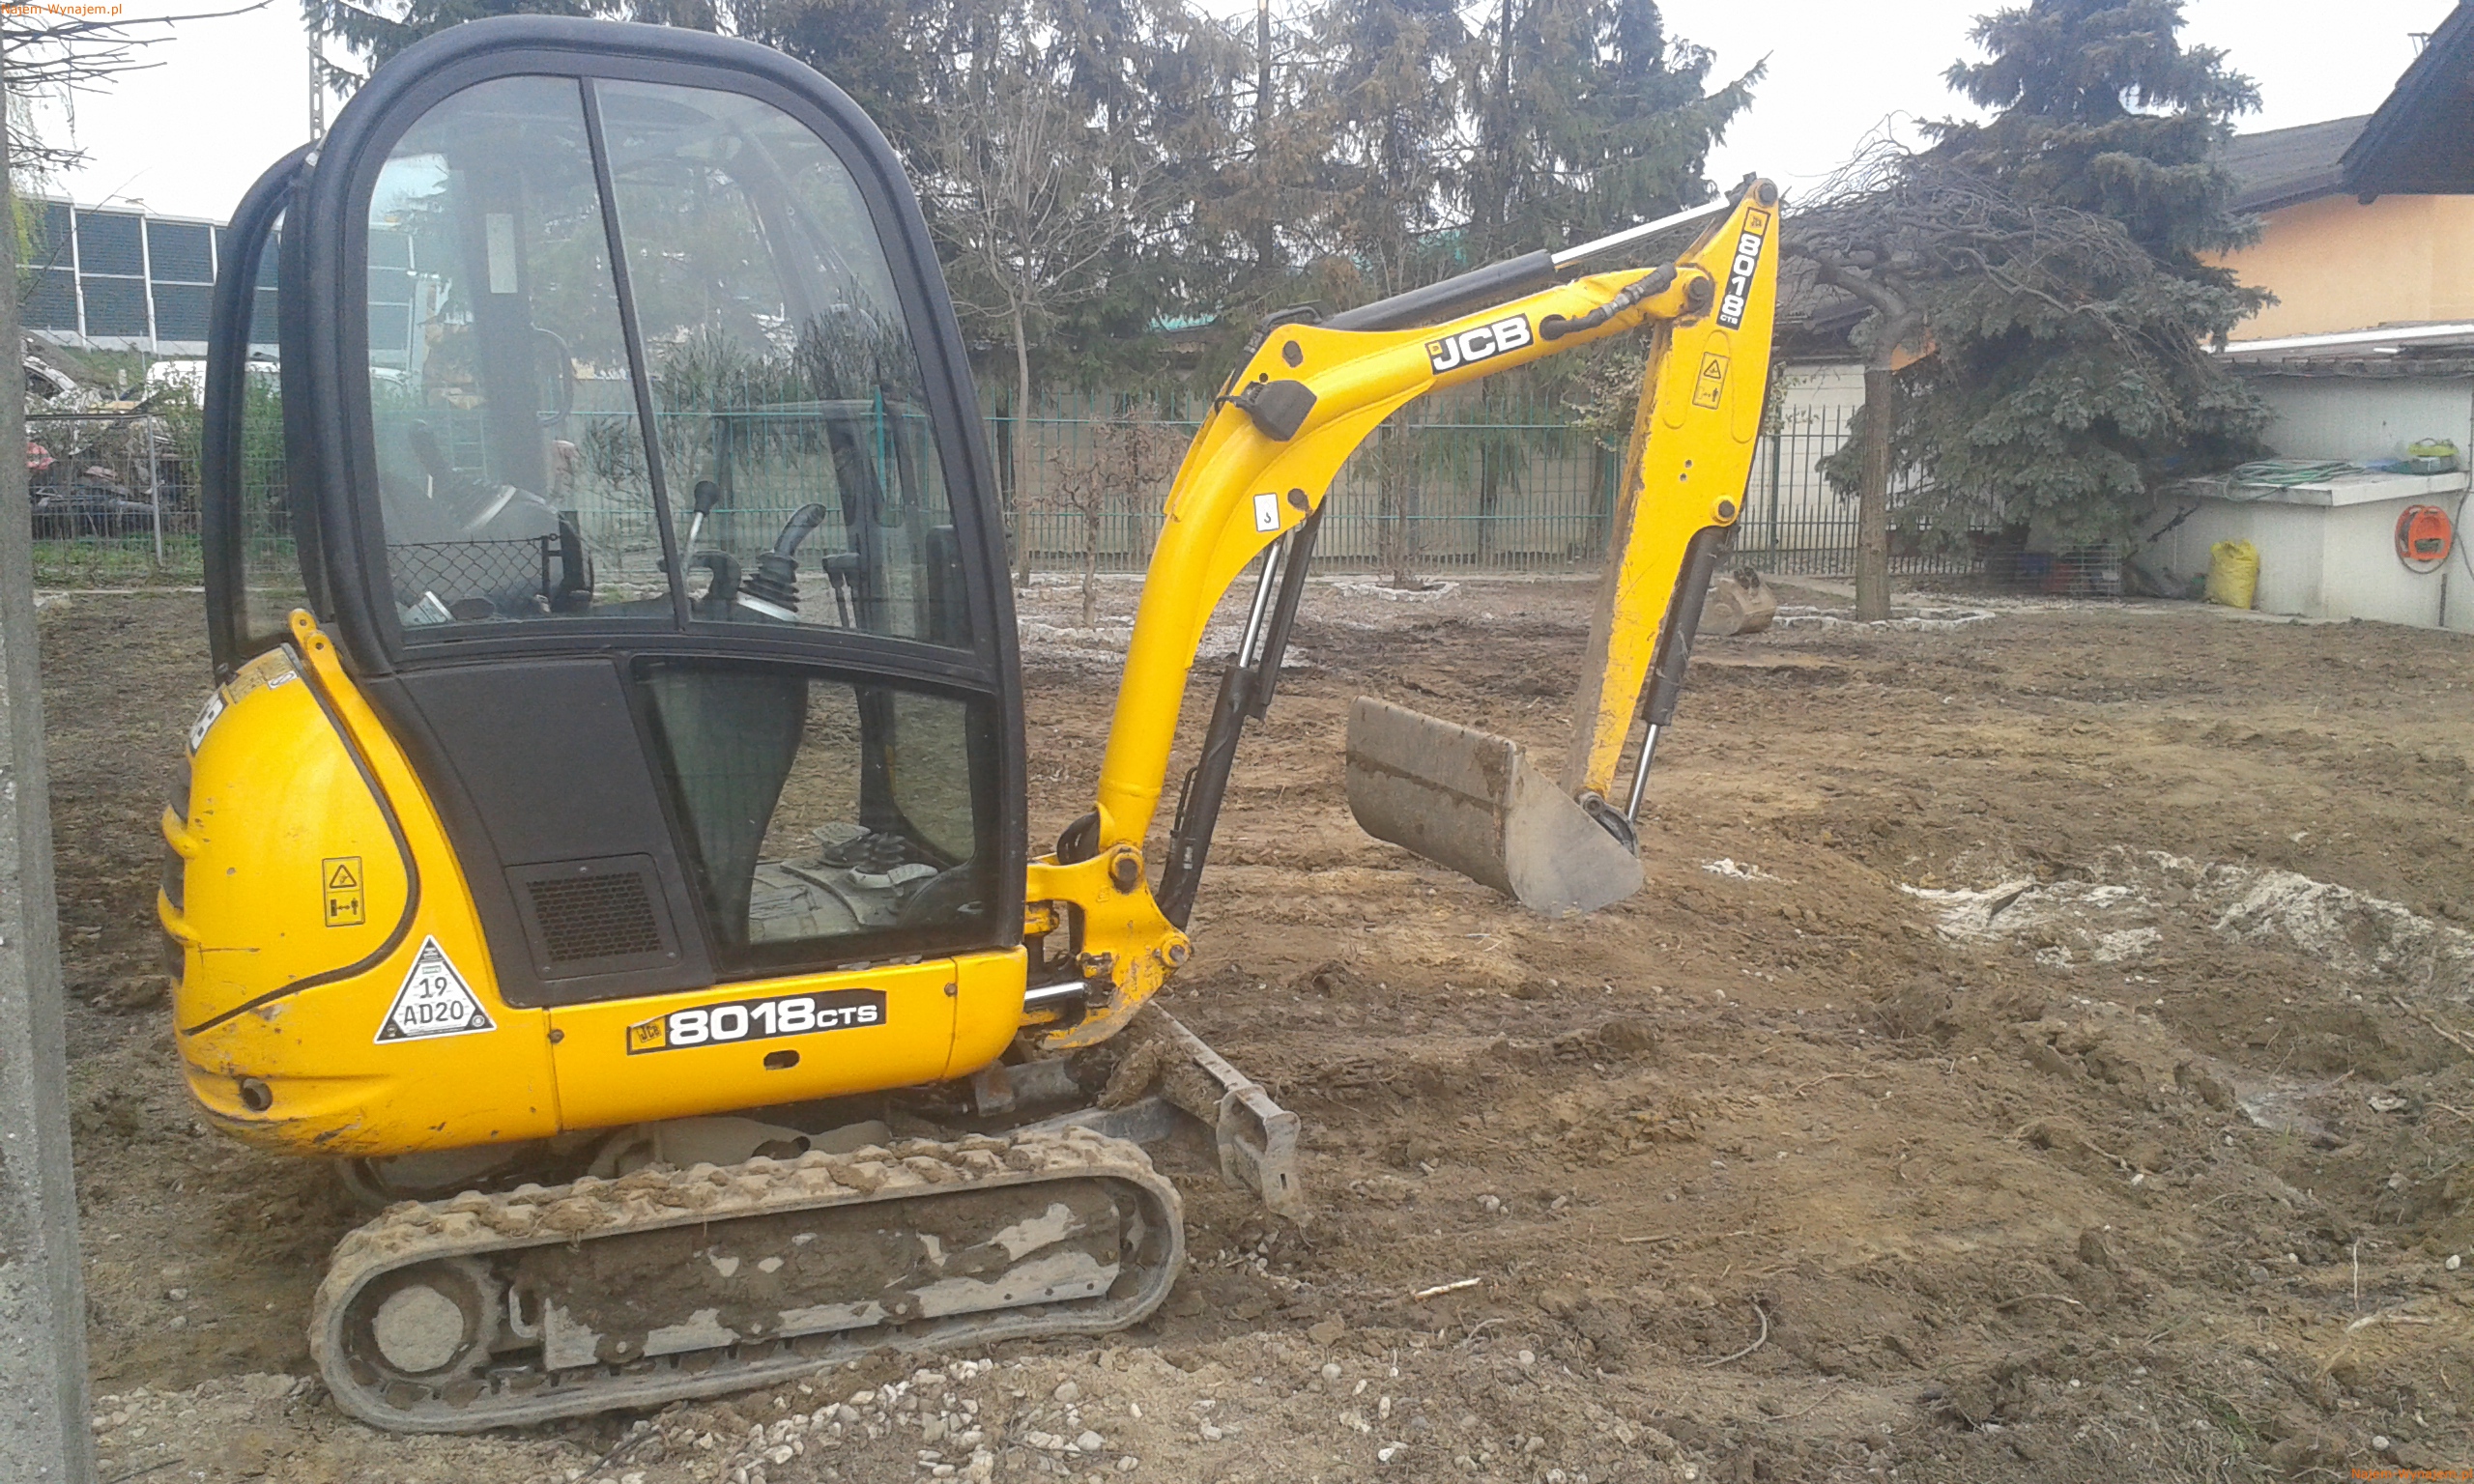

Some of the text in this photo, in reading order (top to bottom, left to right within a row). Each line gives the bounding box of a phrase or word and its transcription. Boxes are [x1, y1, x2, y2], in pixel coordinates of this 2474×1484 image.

[1432, 317, 1531, 371] JCB
[418, 976, 447, 999] 19
[404, 1000, 464, 1025] AD20
